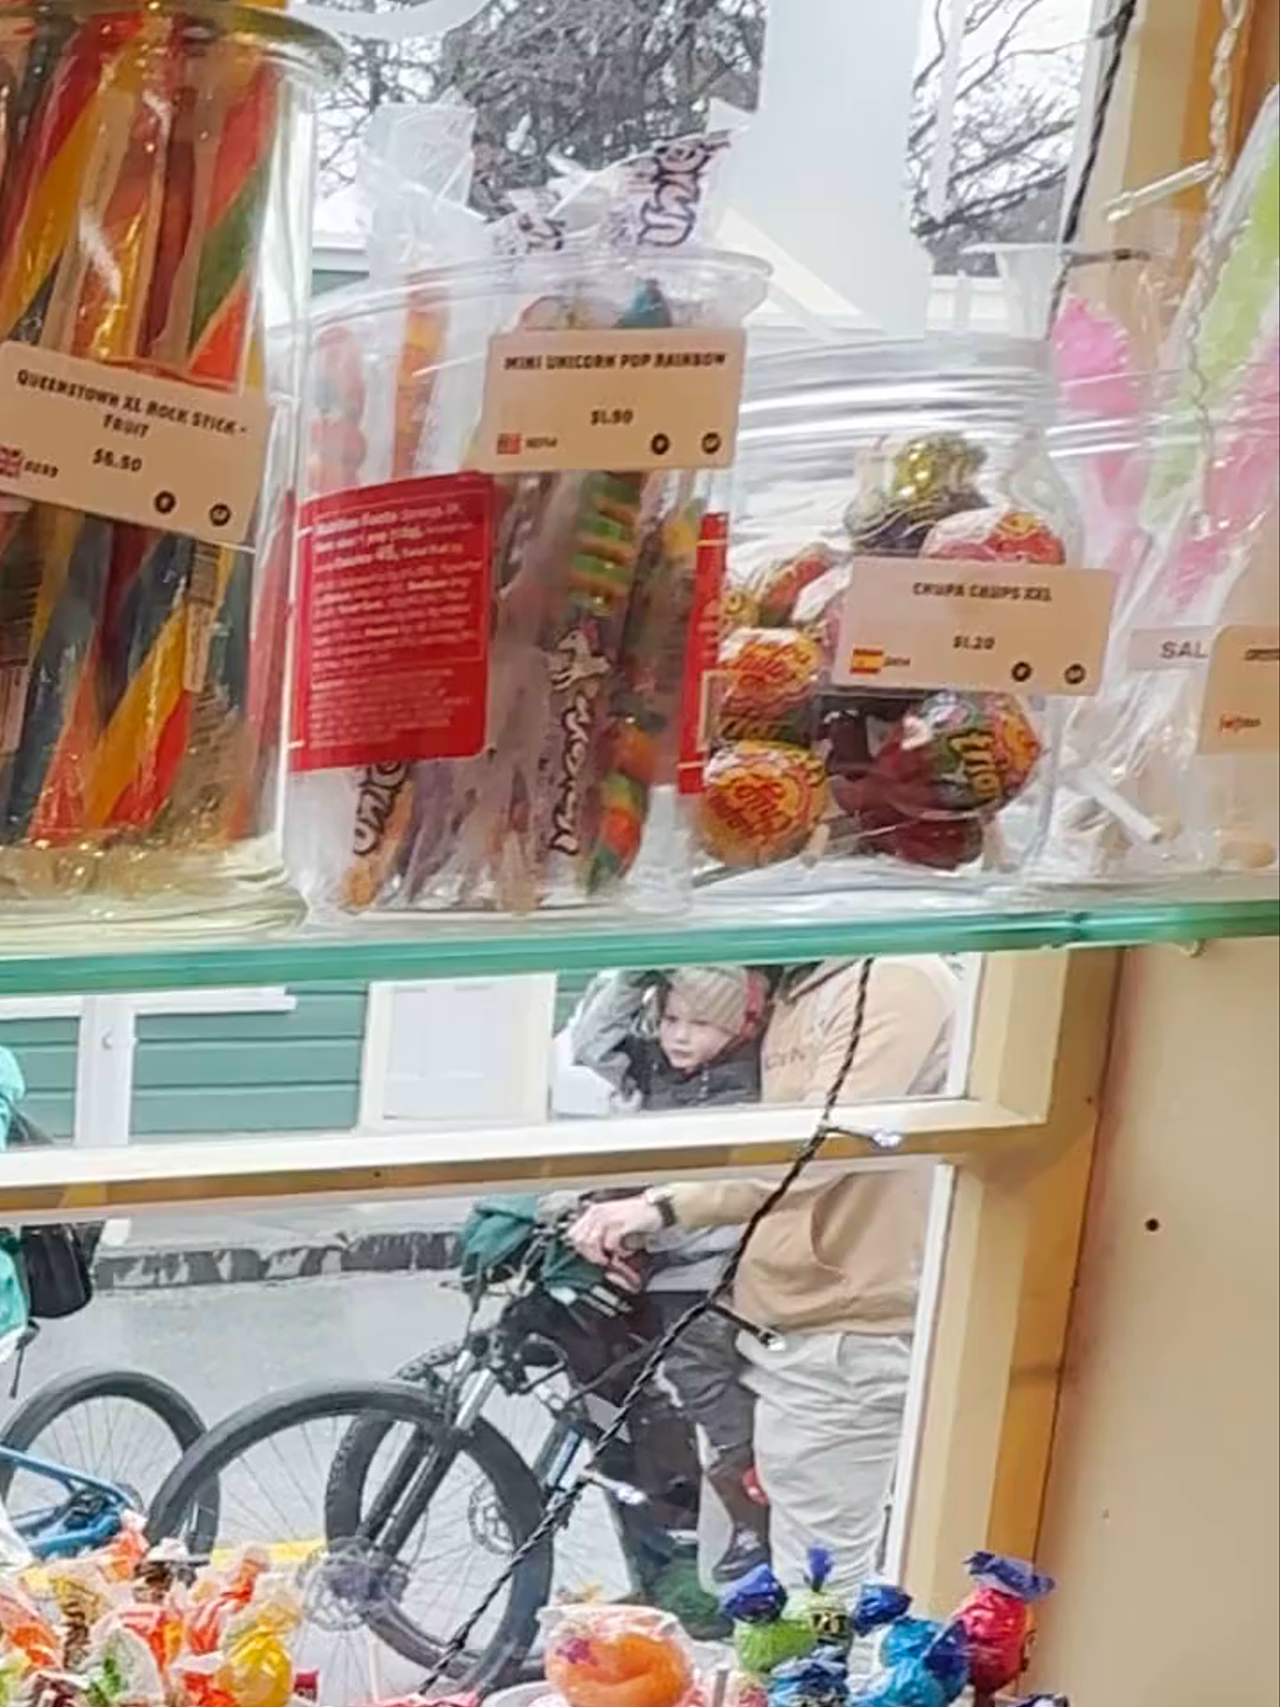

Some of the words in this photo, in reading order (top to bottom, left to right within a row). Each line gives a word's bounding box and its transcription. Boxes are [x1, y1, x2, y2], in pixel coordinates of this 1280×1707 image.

[504, 355, 542, 371] MINI
[546, 354, 615, 370] UNICORN
[620, 353, 651, 369] POP
[654, 352, 726, 368] RAINBOW
[17, 369, 121, 410] QUEENSTOWN
[122, 396, 143, 413] XL
[147, 401, 188, 424] ROCK
[193, 411, 238, 435] STICK
[103, 414, 151, 438] FRUIT
[913, 581, 966, 600] CHUPA
[969, 583, 1020, 602] CHUPS
